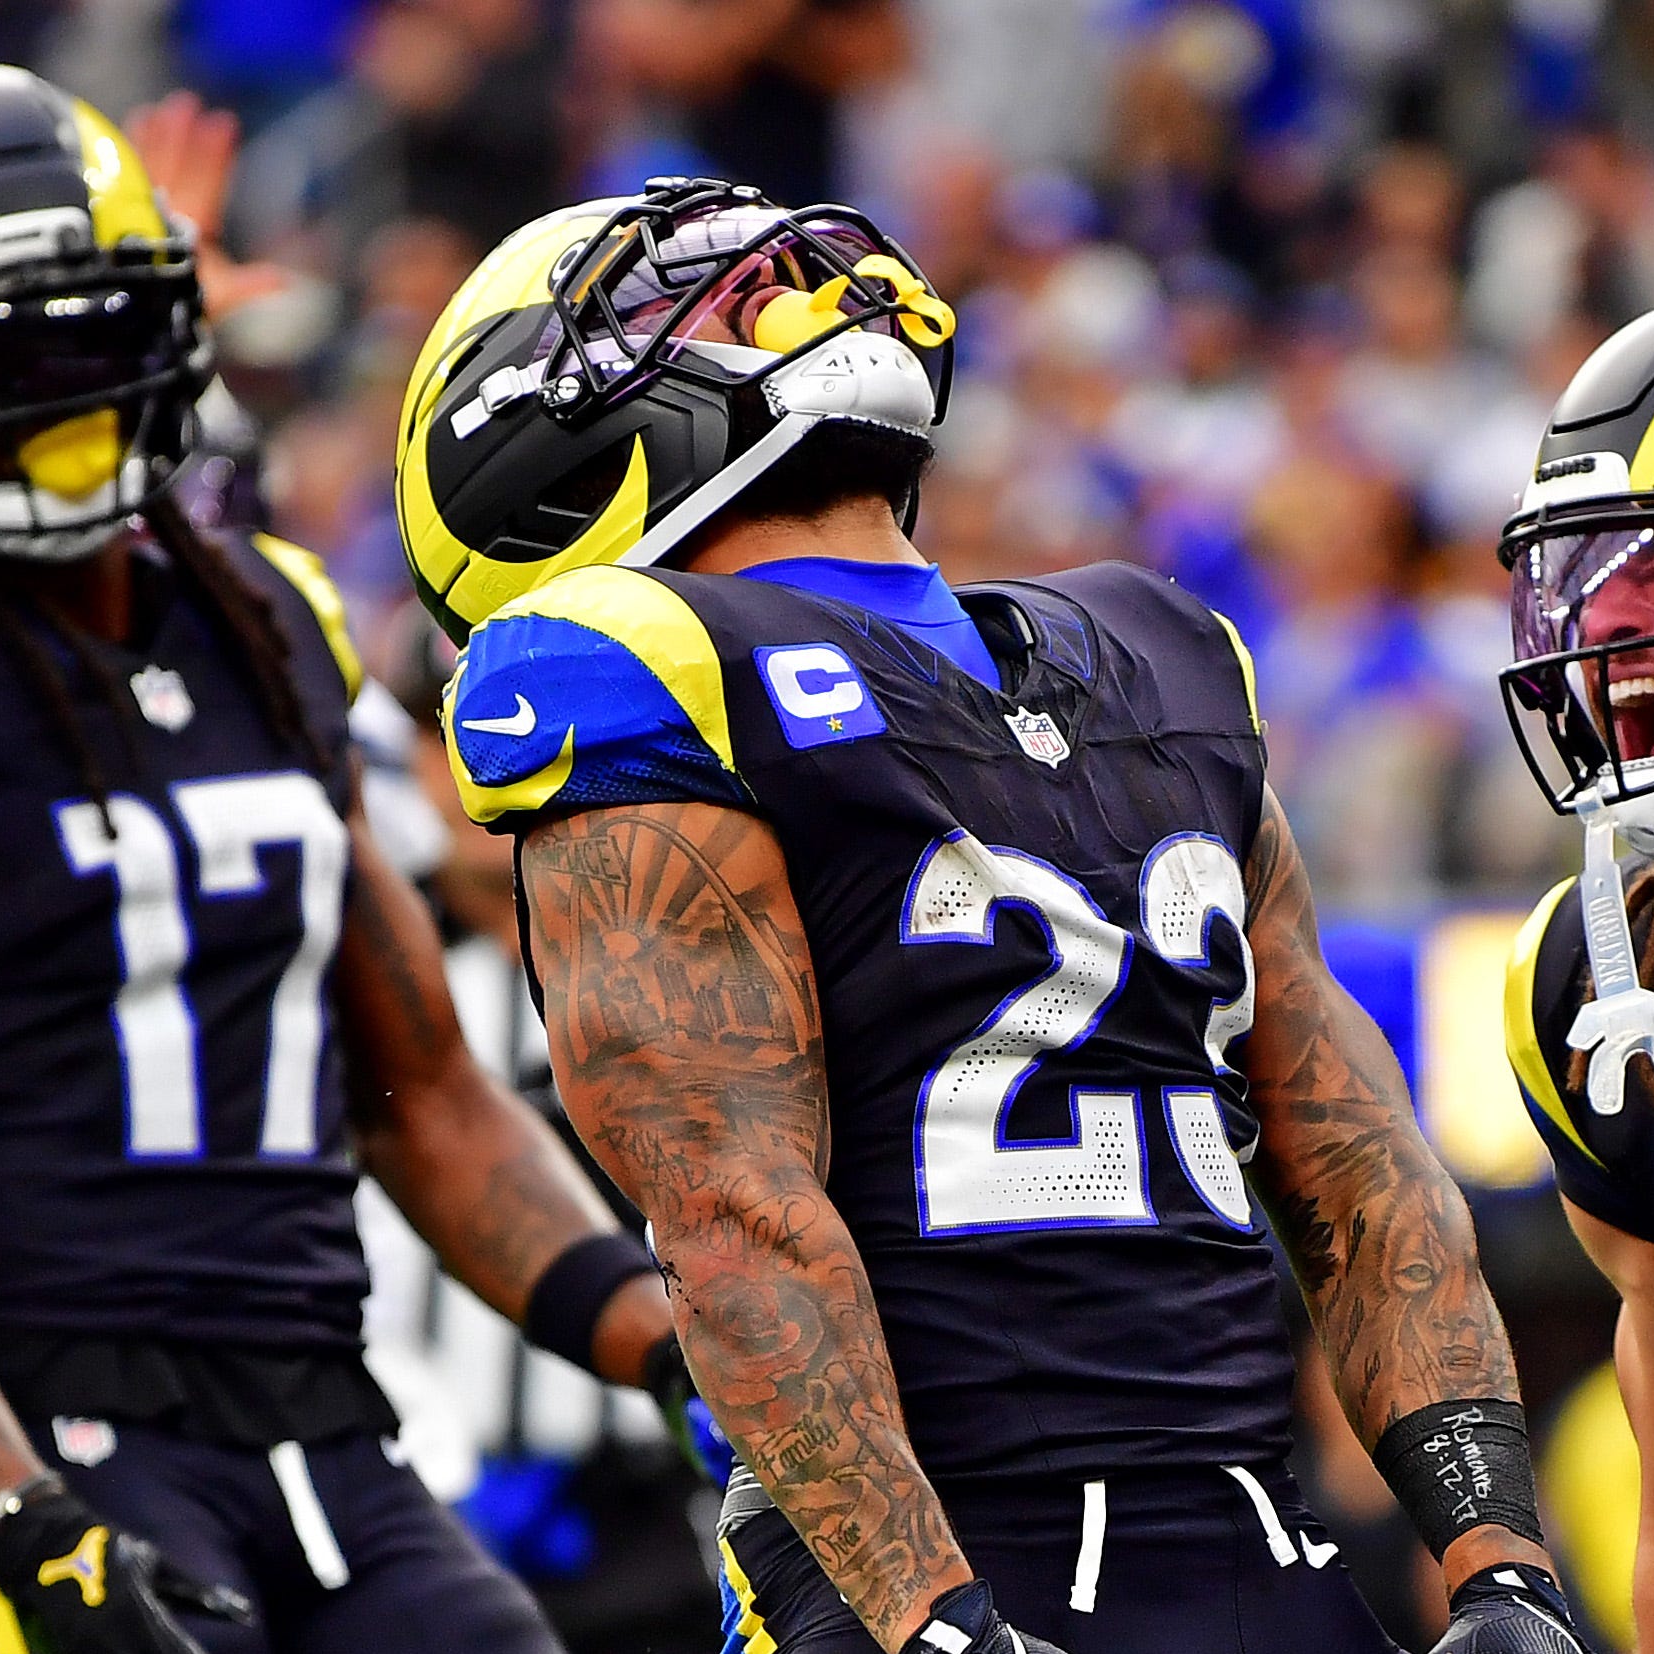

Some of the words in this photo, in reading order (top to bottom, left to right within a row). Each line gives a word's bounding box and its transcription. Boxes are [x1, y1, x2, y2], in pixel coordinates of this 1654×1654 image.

[766, 647, 864, 719] C
[1026, 733, 1061, 755] NFL
[52, 771, 350, 1160] 17
[1441, 1405, 1493, 1499] Romans
